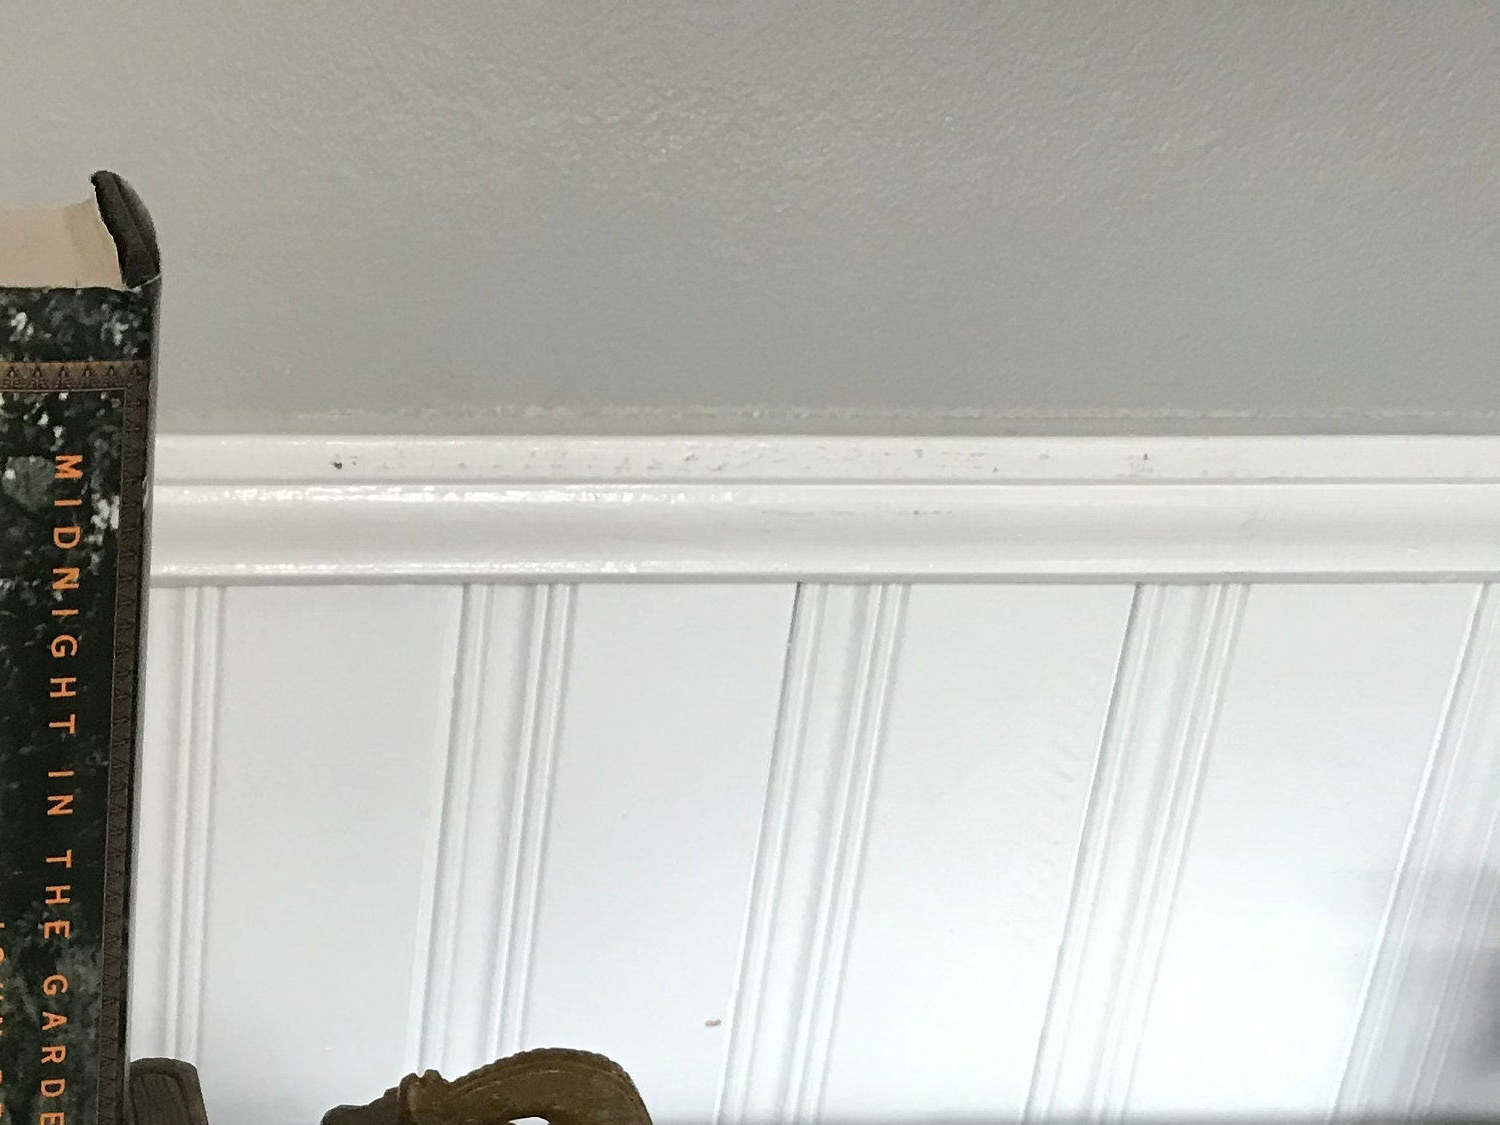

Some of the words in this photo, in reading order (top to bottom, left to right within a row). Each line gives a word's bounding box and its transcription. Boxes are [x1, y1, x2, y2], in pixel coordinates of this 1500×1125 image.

[49, 454, 84, 734] MIDNIGHT
[47, 770, 75, 816] IN
[43, 850, 72, 940] THE
